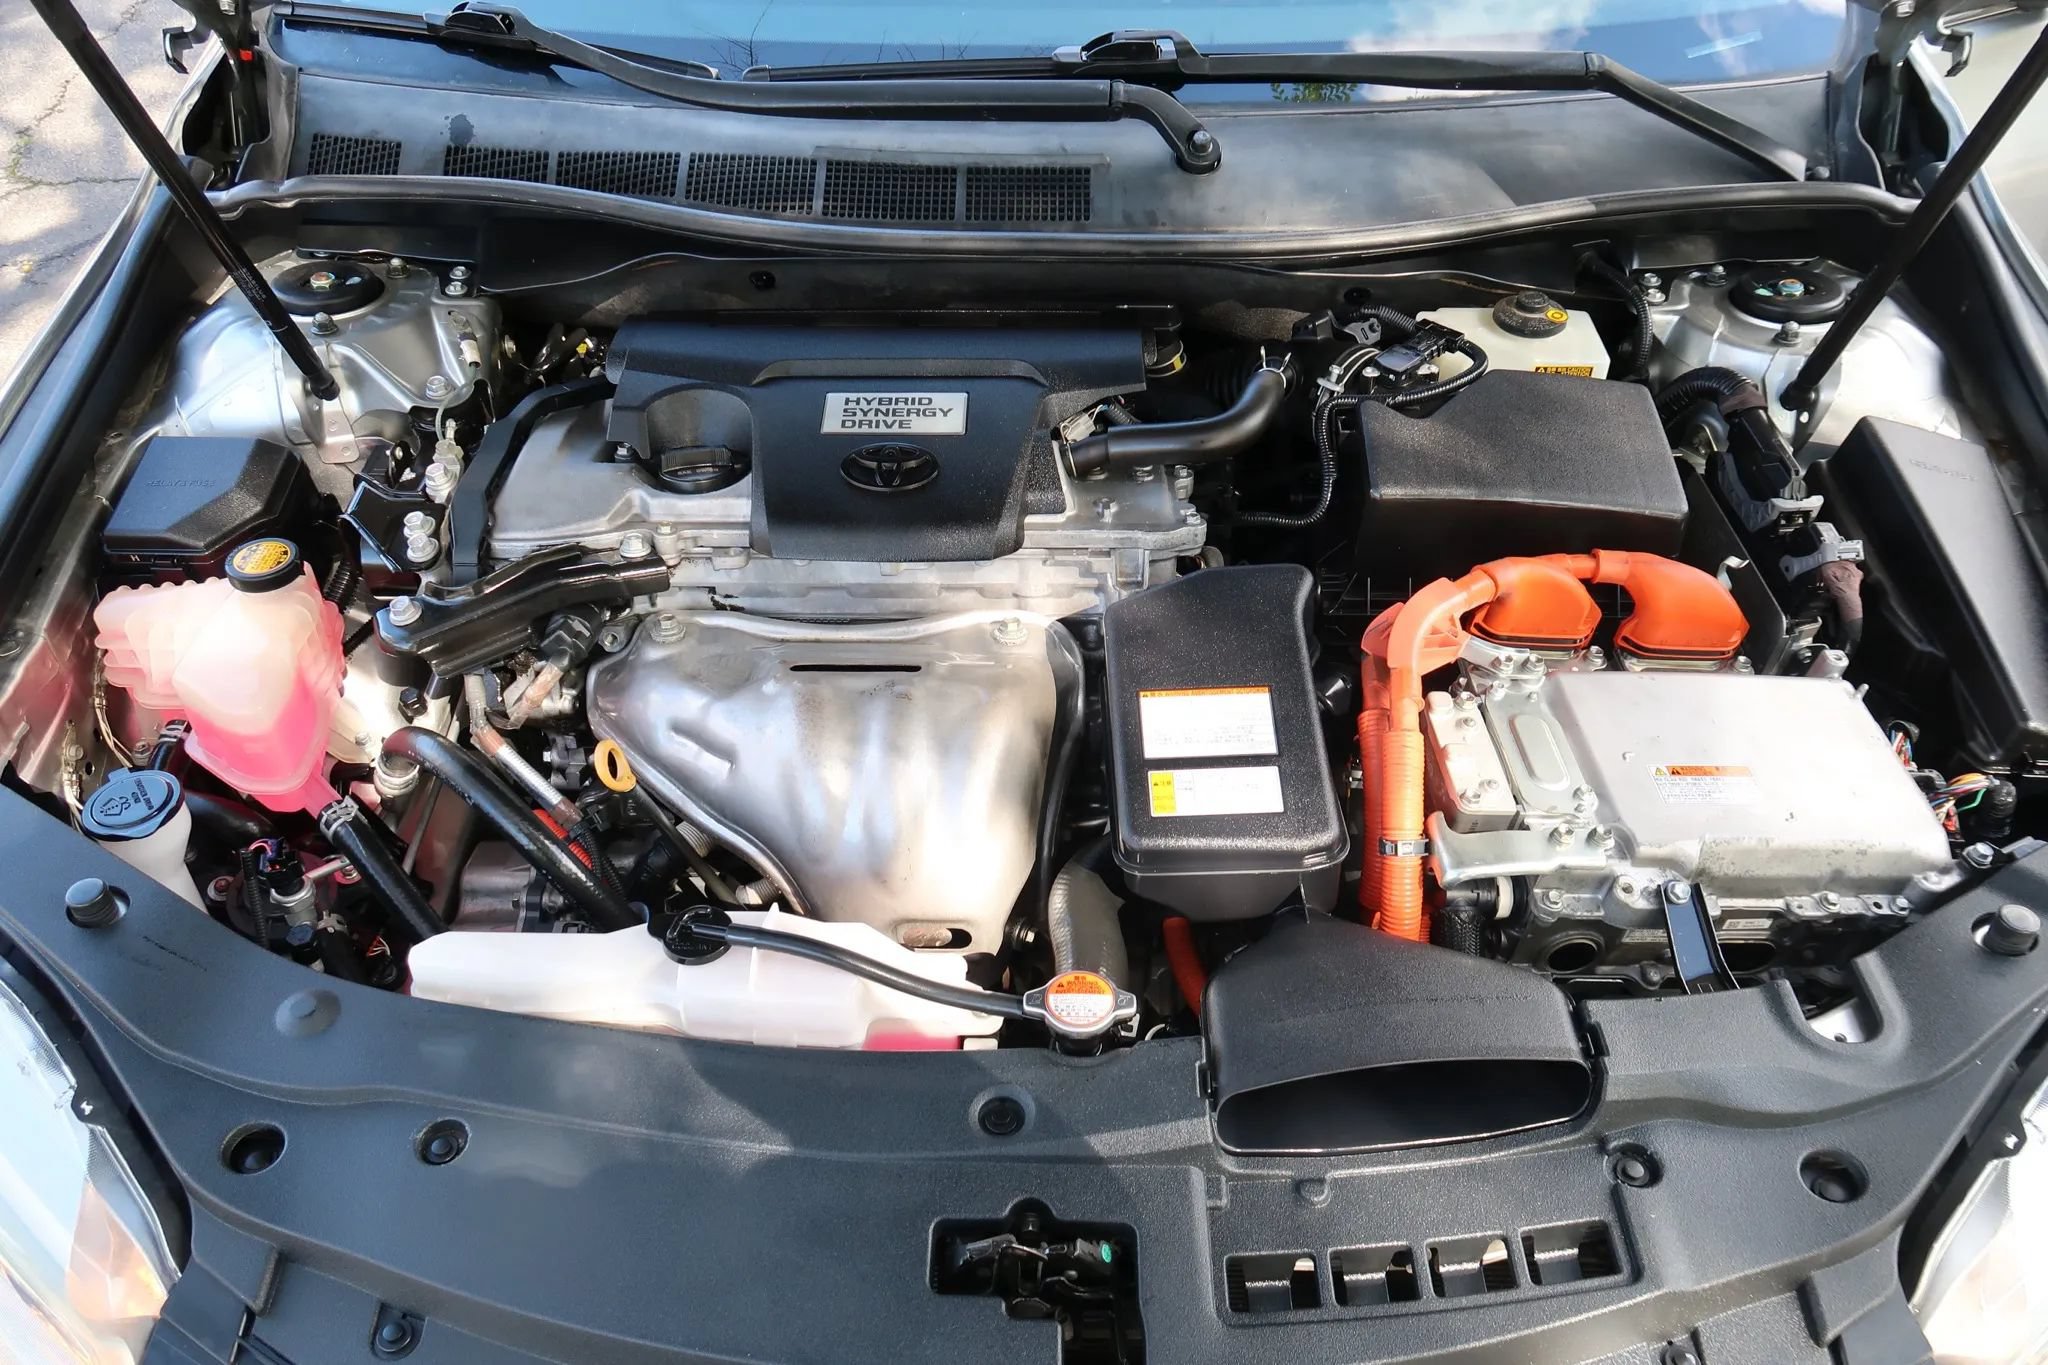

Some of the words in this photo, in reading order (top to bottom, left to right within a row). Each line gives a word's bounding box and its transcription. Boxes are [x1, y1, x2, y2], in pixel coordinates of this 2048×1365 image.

[844, 397, 933, 406] HYBRID
[842, 407, 954, 418] SYNERGY
[840, 419, 913, 429] DRIVE
